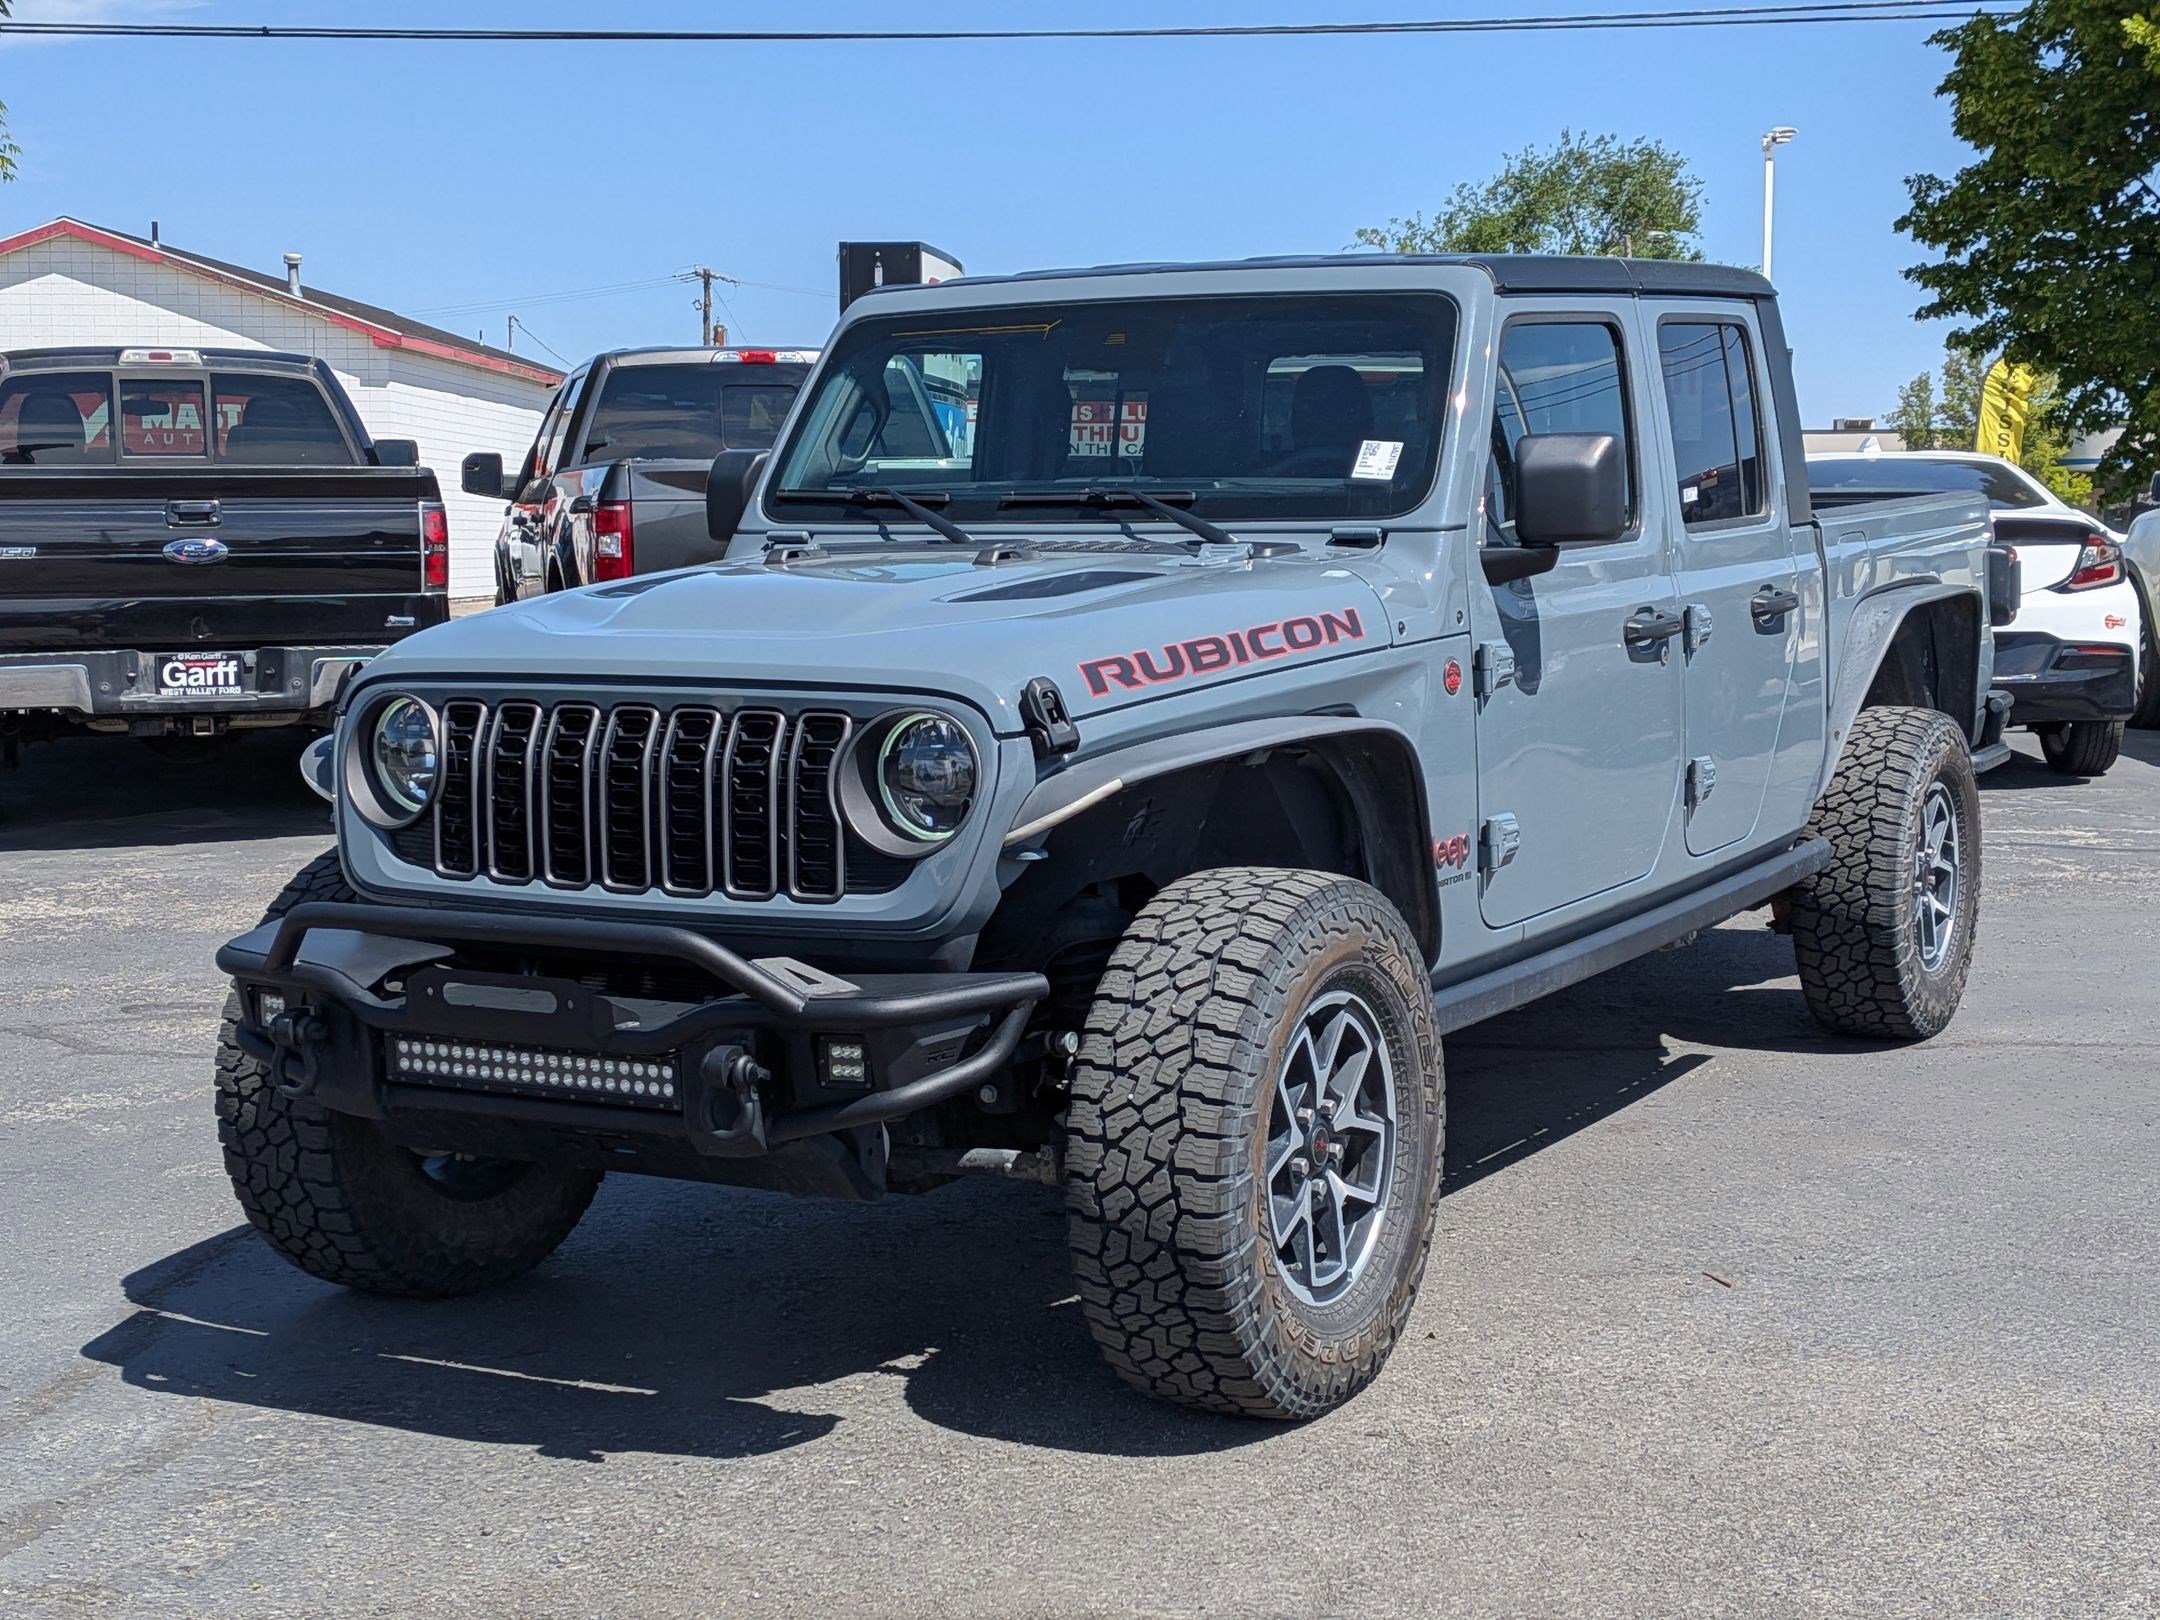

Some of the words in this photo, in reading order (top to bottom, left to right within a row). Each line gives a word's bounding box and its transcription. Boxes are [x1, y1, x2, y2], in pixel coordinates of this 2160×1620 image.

[142, 403, 246, 429] MAT
[1078, 607, 1364, 697] RUBICON
[162, 660, 238, 687] Garff
[160, 687, 184, 696] WEST
[185, 686, 217, 695] VALLEY
[218, 685, 242, 695] FORD
[1433, 833, 1471, 870] eep
[1362, 939, 1438, 1115] FALKEN
